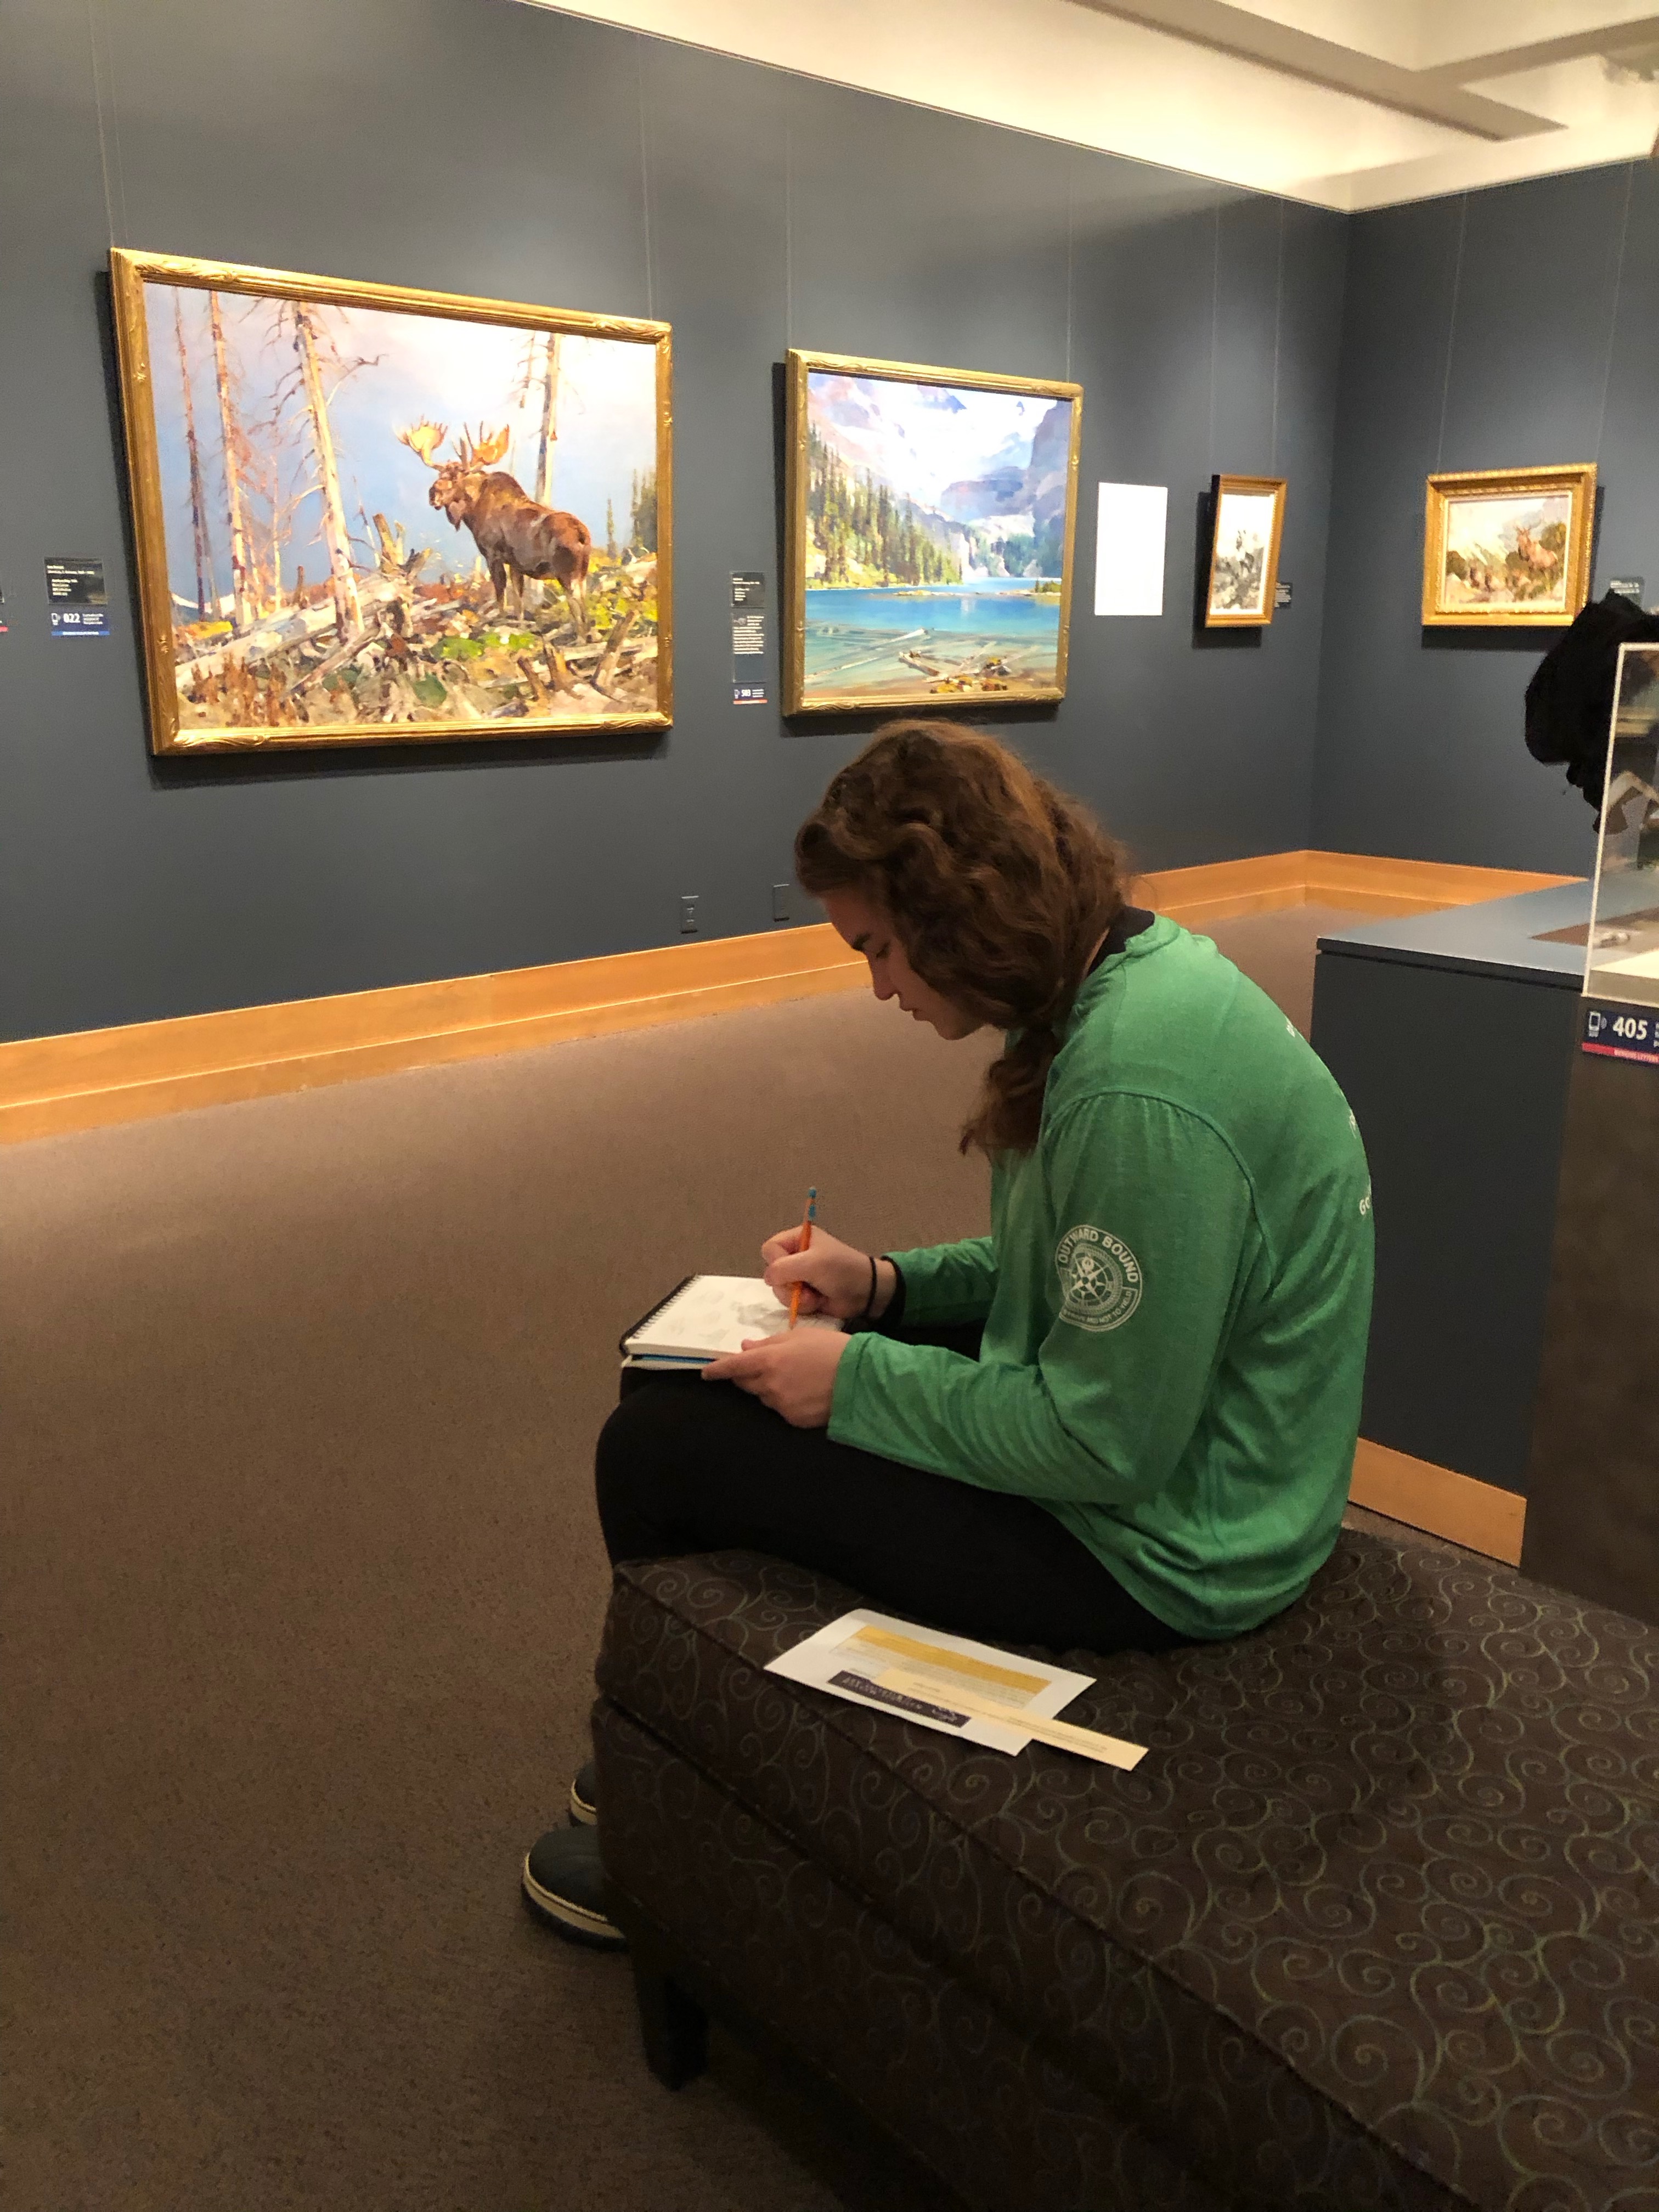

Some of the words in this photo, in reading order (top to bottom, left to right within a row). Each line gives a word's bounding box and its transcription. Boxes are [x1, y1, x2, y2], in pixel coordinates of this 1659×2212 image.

[1613, 1017, 1648, 1040] 405
[1058, 1228, 1099, 1263] OUTWARD
[1102, 1236, 1139, 1283] BOUND
